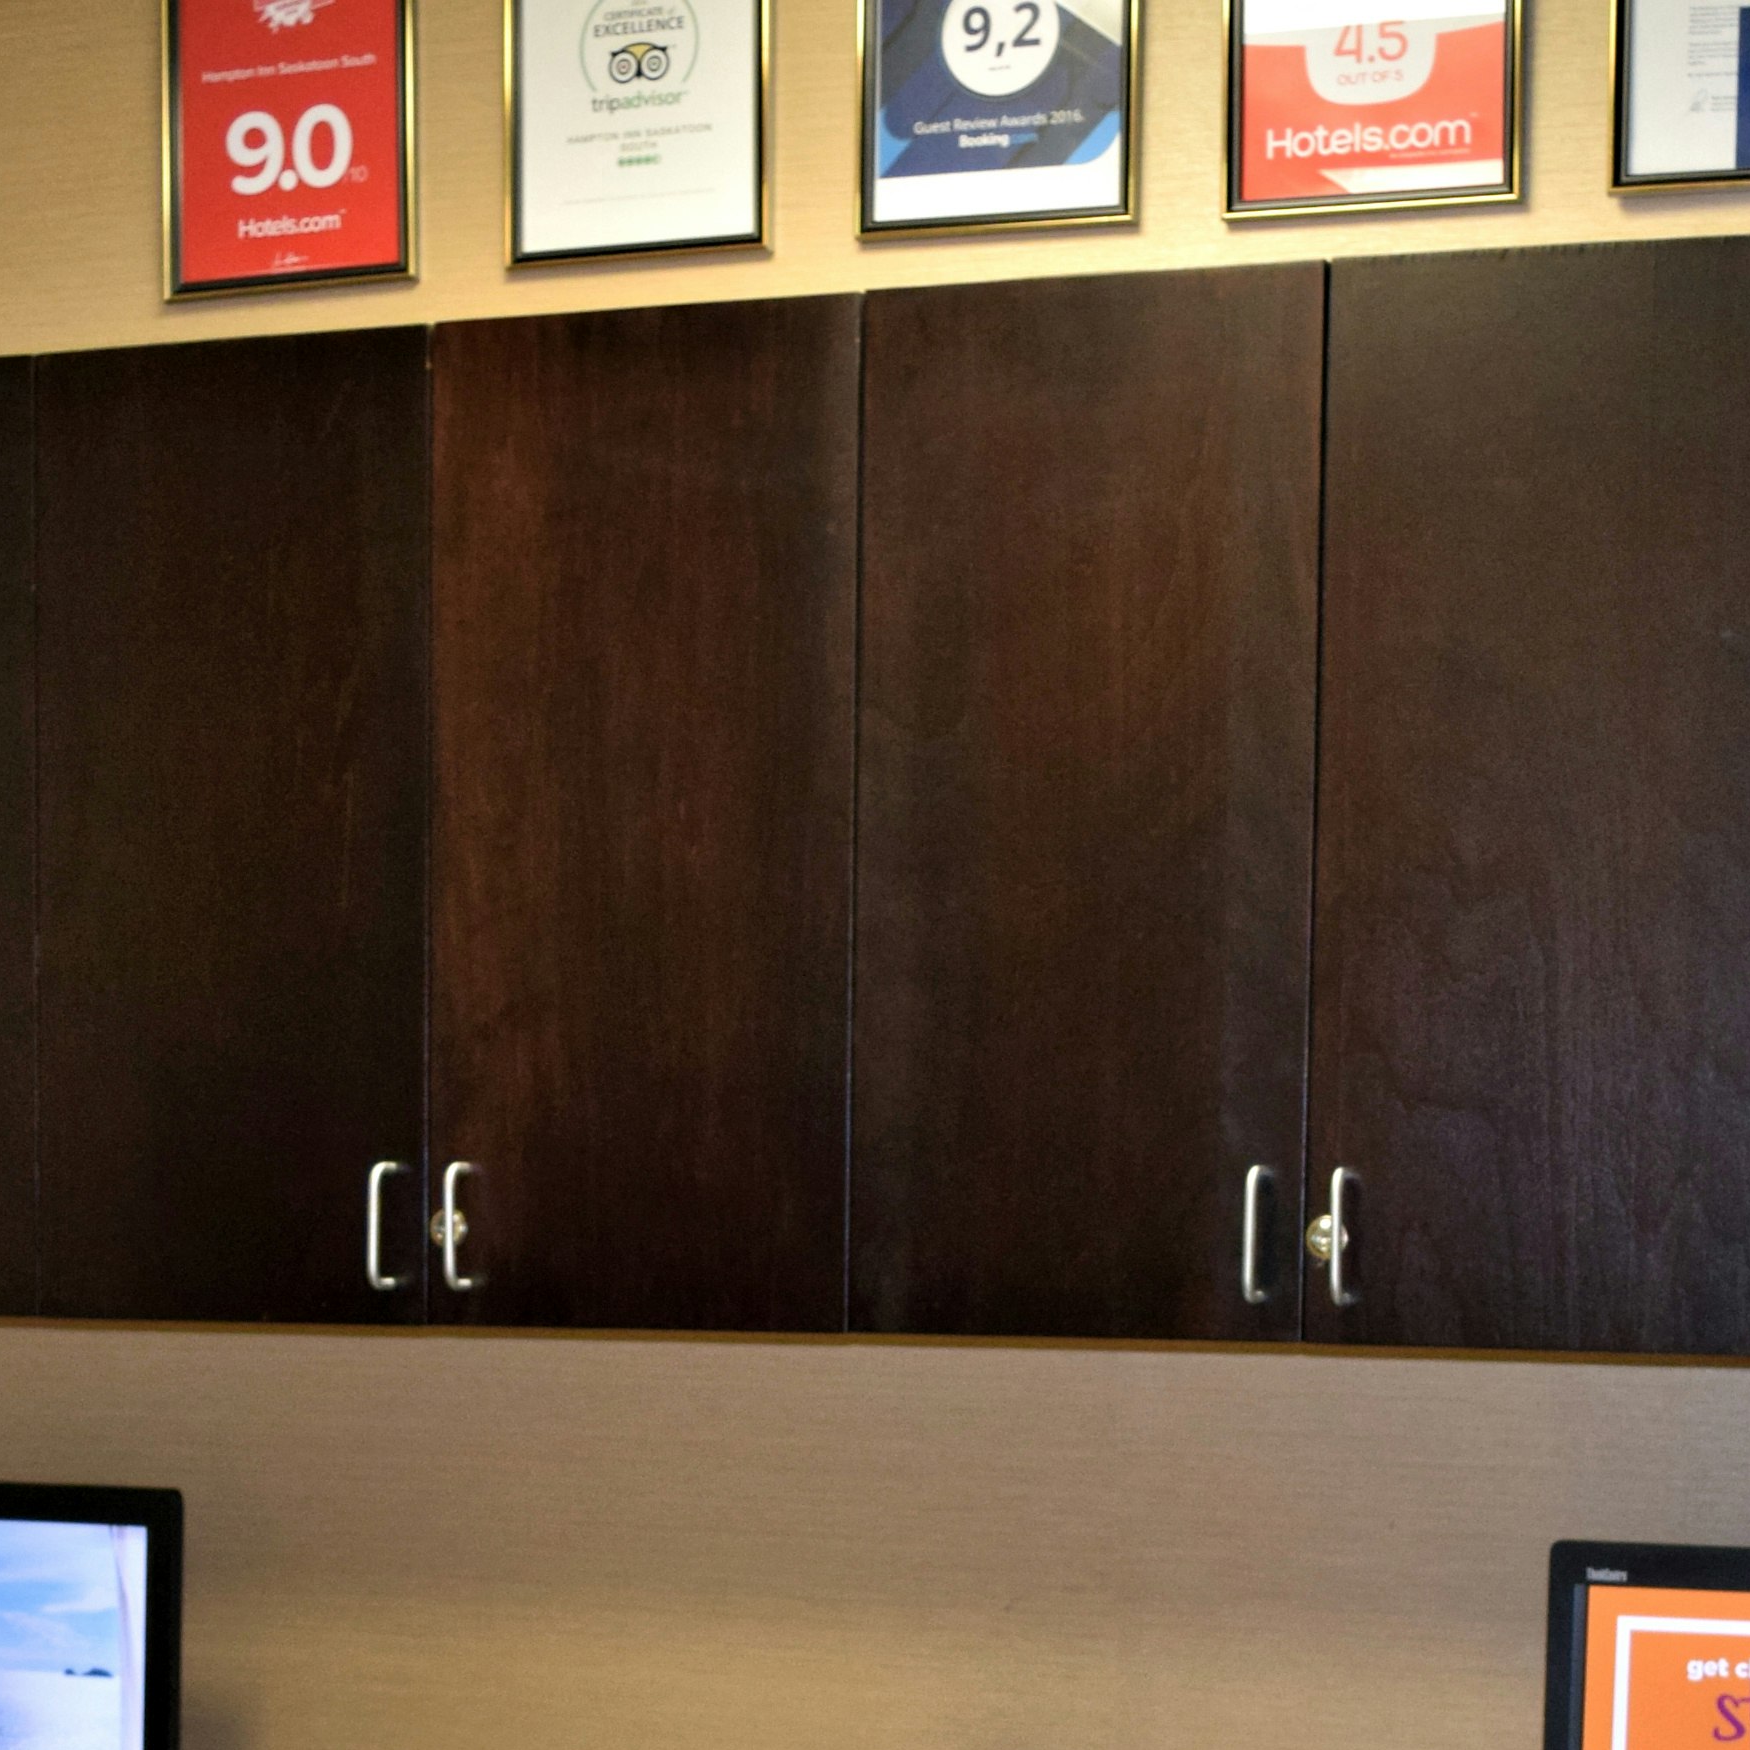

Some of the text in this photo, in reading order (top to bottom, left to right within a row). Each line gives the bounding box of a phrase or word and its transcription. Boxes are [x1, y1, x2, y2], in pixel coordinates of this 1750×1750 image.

[593, 15, 684, 38] EXCELLENCE
[603, 7, 663, 21] CERTIFICATE
[962, 2, 1041, 57] 9,2
[1333, 20, 1408, 64] 4.5
[201, 67, 255, 83] Hampton
[277, 58, 338, 75] Saskatoon
[340, 53, 377, 68] South
[1336, 71, 1367, 86] OUT
[1371, 69, 1390, 83] OF
[591, 88, 682, 114] tripadvisor
[913, 120, 951, 135] Guest
[953, 116, 998, 131] Review
[1000, 112, 1048, 128] Awards
[225, 103, 353, 196] 9.0
[958, 132, 1038, 148] Booking.com
[1266, 119, 1471, 160] Hotels.com
[237, 213, 342, 239] Hotels.com
[1687, 1658, 1729, 1681] get
